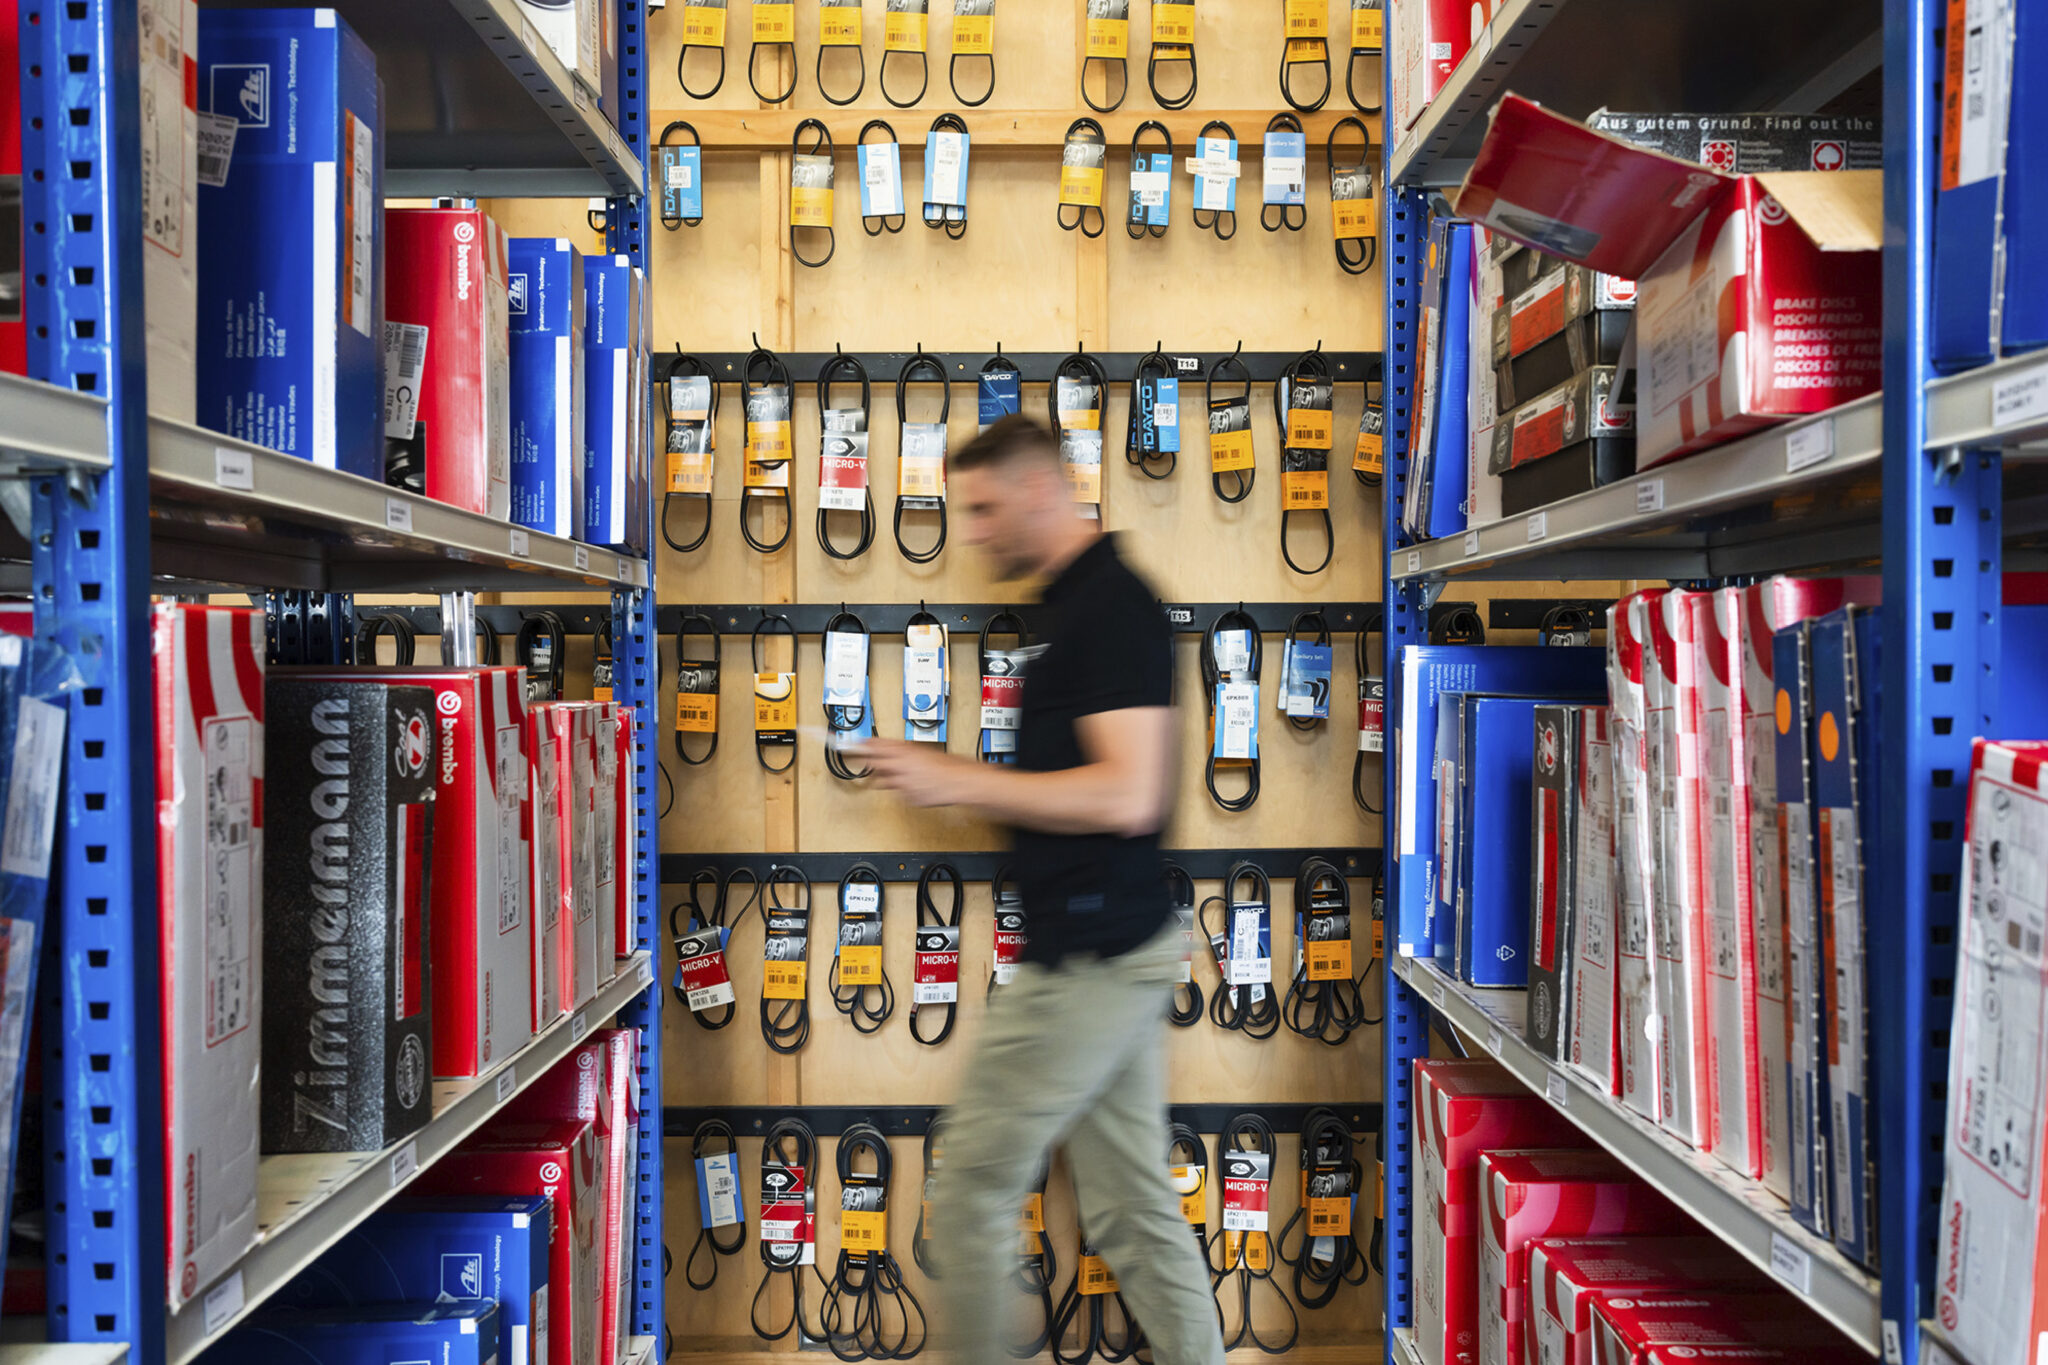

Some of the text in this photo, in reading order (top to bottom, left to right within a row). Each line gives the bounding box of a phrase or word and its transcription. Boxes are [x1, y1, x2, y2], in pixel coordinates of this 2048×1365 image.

[239, 69, 264, 121] Ate
[288, 38, 299, 153] Brakethrough Technology
[1598, 116, 1874, 133] Aus gutem Grund. Find out the
[457, 245, 472, 300] brembo
[538, 257, 547, 331] Brakethrough Technology
[597, 272, 606, 344] Brakethrough Technology
[1773, 298, 1816, 310] BRAKE
[1773, 313, 1817, 326] DISCHI
[1179, 360, 1197, 369] T14
[1773, 343, 1830, 358] DISQUES
[1773, 359, 1821, 374] DISCOS
[1823, 360, 1839, 372] DE
[1142, 385, 1154, 447] DAYCO
[823, 458, 866, 470] MICRO-V
[1172, 612, 1188, 622] T15
[983, 677, 1025, 689] MICRO-V
[394, 708, 407, 778] Coat
[442, 717, 458, 785] brembo
[294, 698, 350, 1133] Zimmermann
[998, 935, 1032, 945] MICRO-
[681, 955, 721, 974] MICRO-V
[922, 954, 958, 966] MICRO-V
[1574, 968, 1583, 1038] brembo
[577, 1070, 593, 1120] brembo
[1225, 1181, 1268, 1193] MICRO-V
[184, 1153, 196, 1258] brembo
[494, 1234, 502, 1272] Technology
[1946, 1200, 1963, 1294] brembo
[461, 1258, 478, 1296] Ate
[1637, 1299, 1711, 1308] brembo
[1700, 1348, 1785, 1358] brembo
